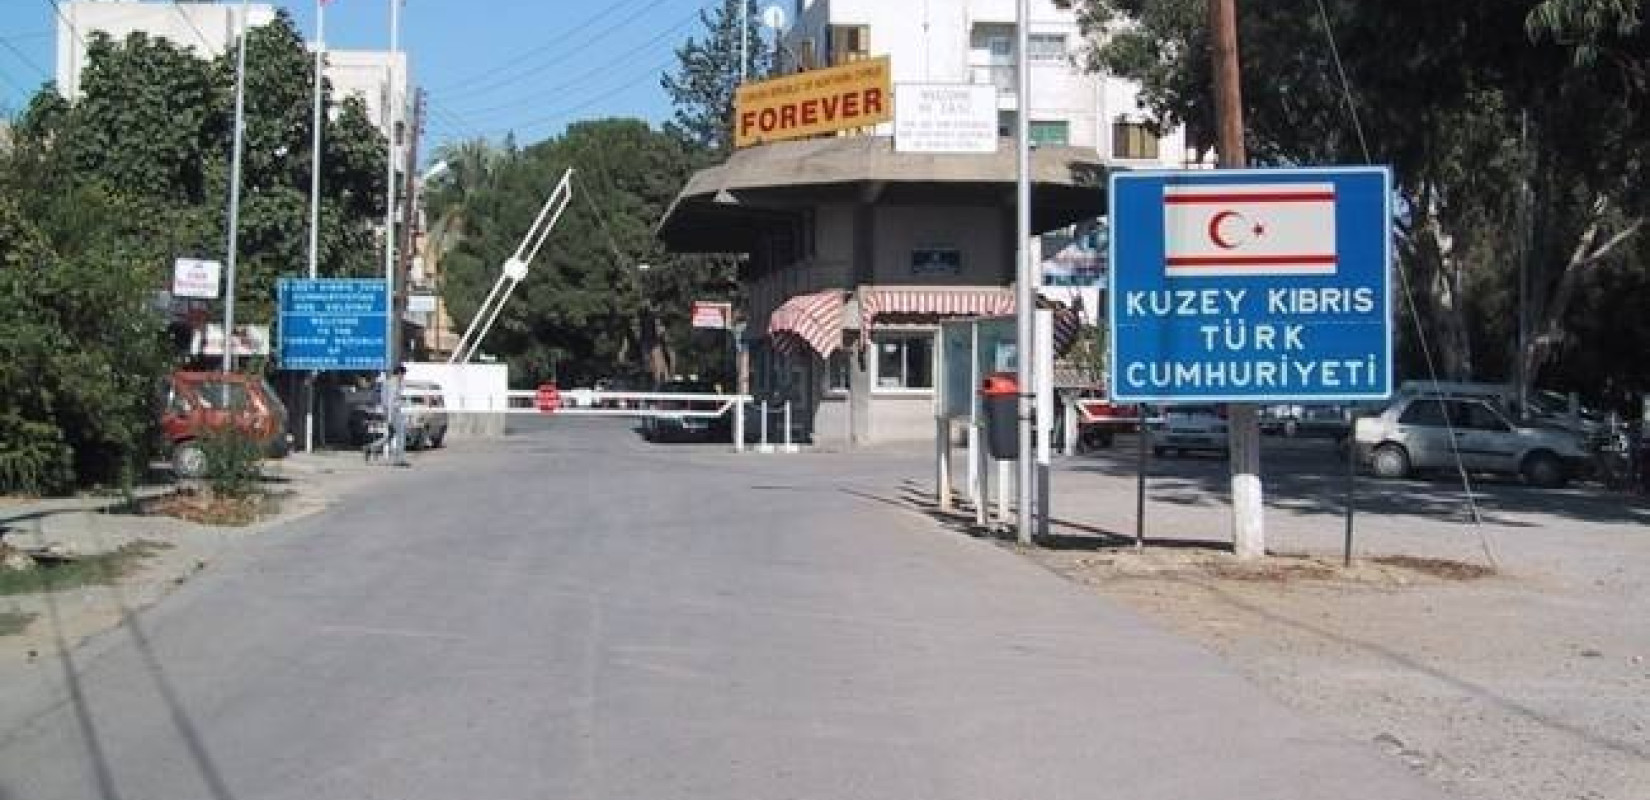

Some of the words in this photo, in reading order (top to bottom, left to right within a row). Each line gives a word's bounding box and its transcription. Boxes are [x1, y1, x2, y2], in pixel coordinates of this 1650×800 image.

[741, 88, 882, 136] FOREVER
[1126, 289, 1247, 316] KUZEY
[1268, 287, 1375, 315] KIBRIS
[1200, 318, 1305, 351] TÜRK
[1126, 353, 1377, 388] CUMHURİYETİ
